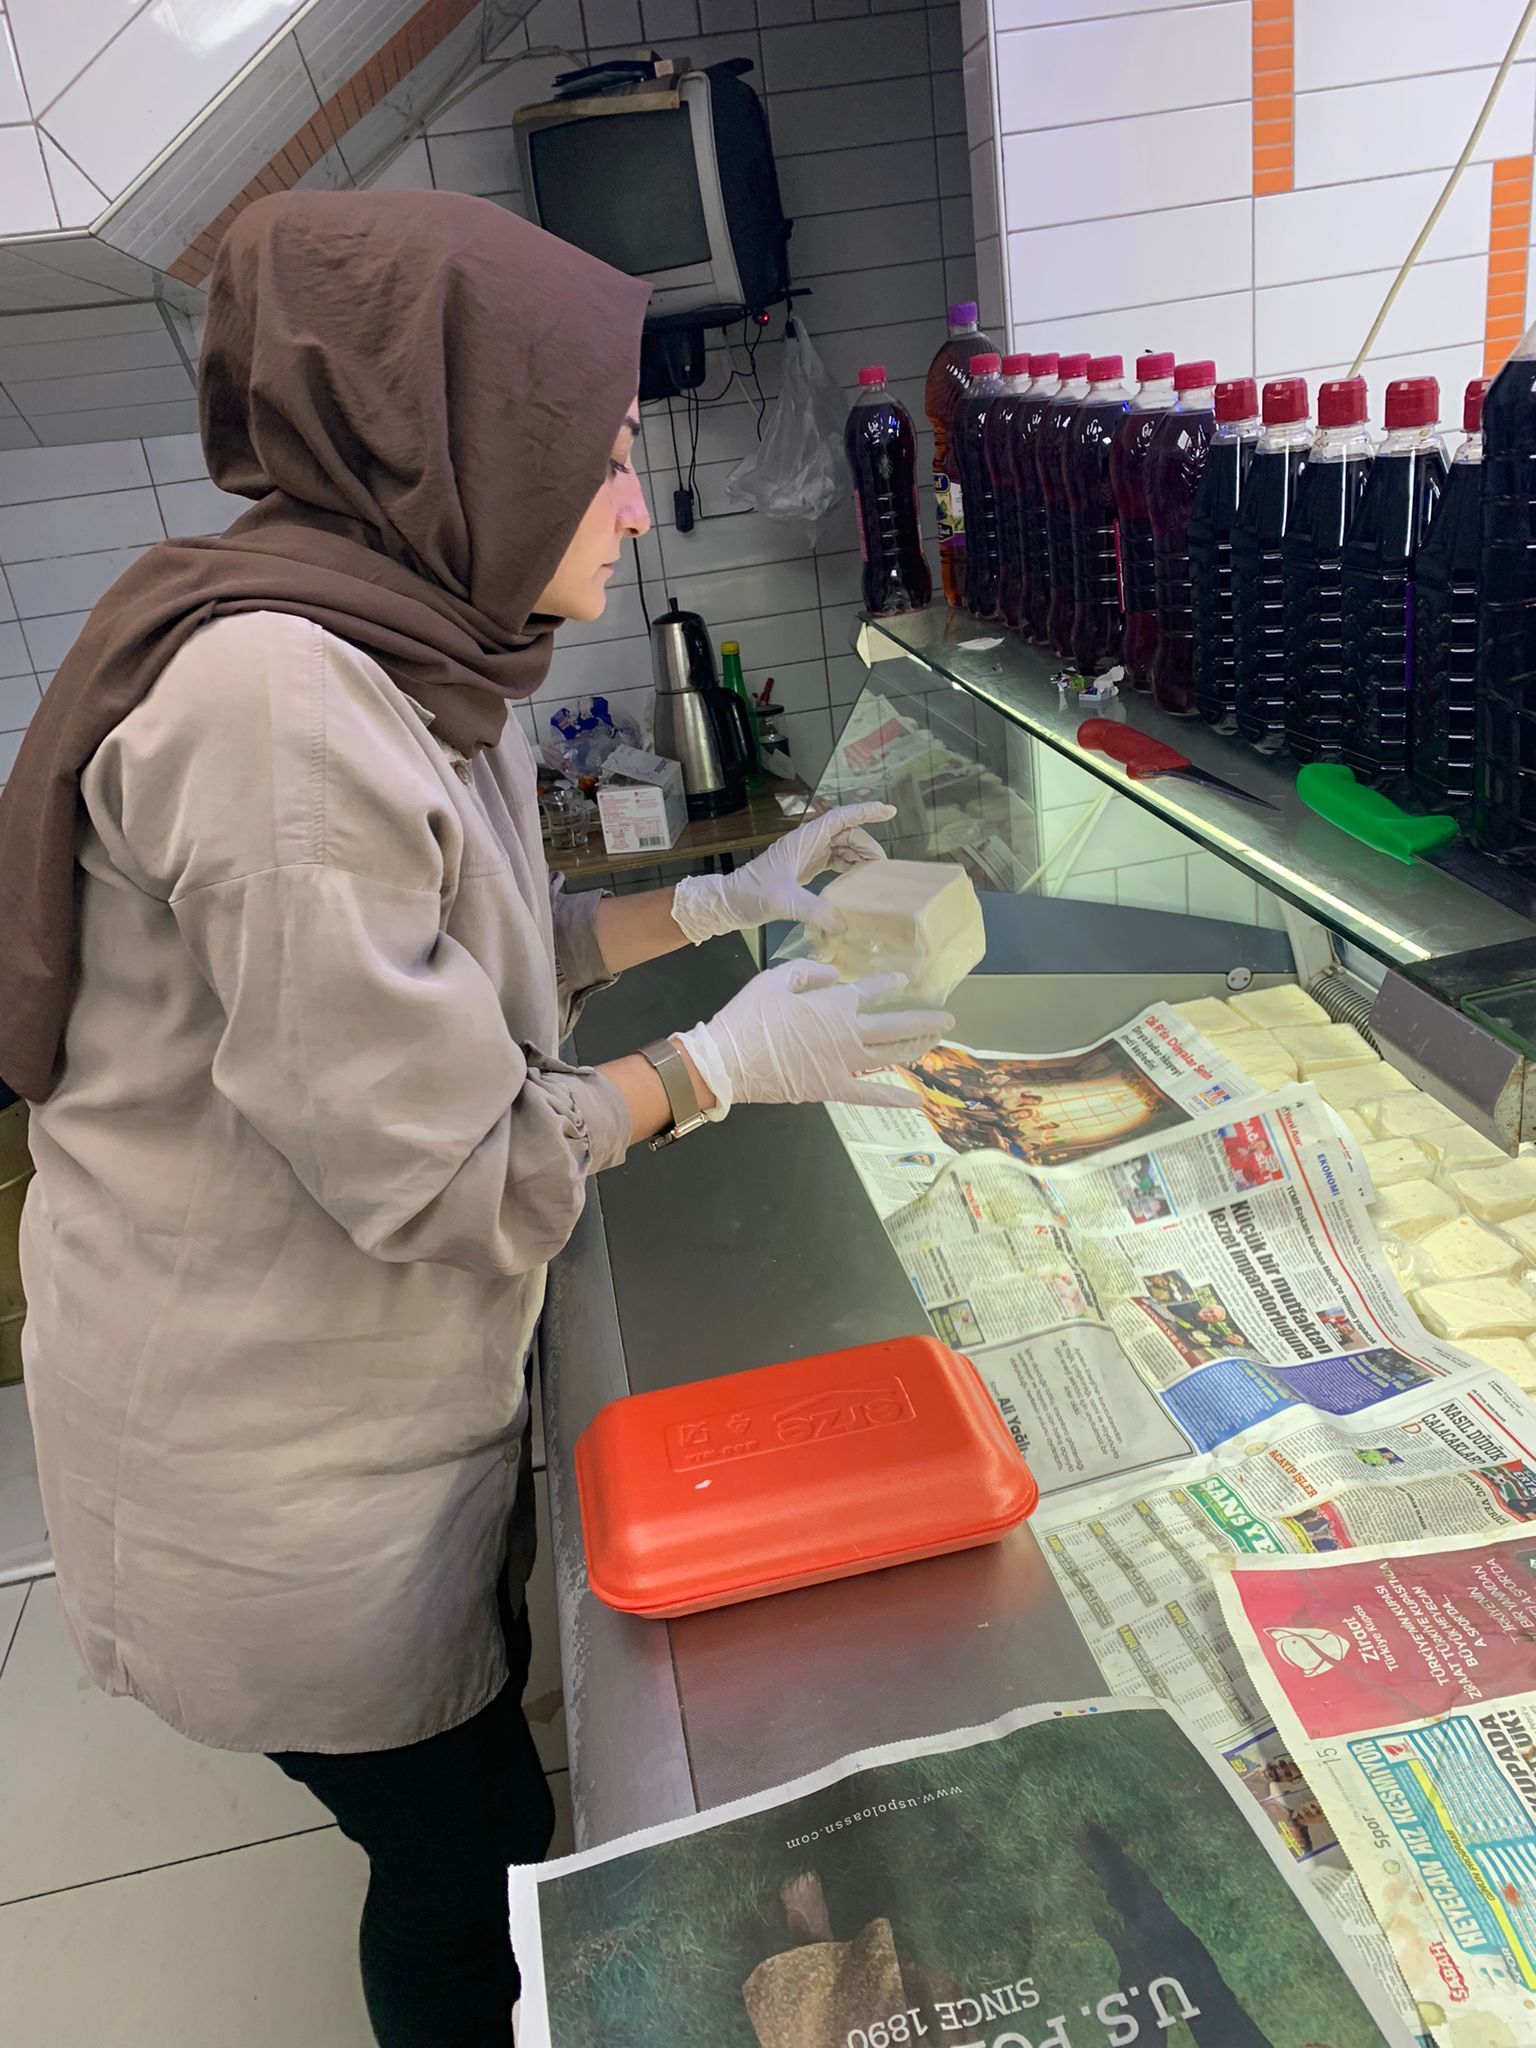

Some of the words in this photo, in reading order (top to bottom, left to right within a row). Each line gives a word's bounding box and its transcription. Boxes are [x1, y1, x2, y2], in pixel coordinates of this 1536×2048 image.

[1208, 1207, 1242, 1252] lezzet
[1230, 1248, 1314, 1360] imparatorluğuna
[1229, 1200, 1267, 1253] Küçük
[1255, 1252, 1281, 1276] bir
[1271, 1277, 1333, 1354] mutfaktan
[997, 1395, 1015, 1416] Ali
[1009, 1414, 1031, 1453] Yağlı
[1418, 1413, 1487, 1465] ÇALACAKLAR?
[1440, 1403, 1475, 1435] NASIL
[1466, 1429, 1507, 1461] DÜDÜK
[1269, 1448, 1297, 1476] ACAYİP
[1290, 1472, 1318, 1499] İŞLER
[1352, 1603, 1377, 1633] Kupası
[1374, 1582, 1405, 1618] KUPASI
[1411, 1584, 1451, 1631] HEYECAN
[1343, 1617, 1380, 1665] Ziraat
[1371, 1630, 1399, 1672] Türkiye
[1416, 1615, 1455, 1662] TÜRKİYE
[1445, 1627, 1478, 1669] BÜYÜK
[1474, 1636, 1487, 1650] A
[1447, 1658, 1483, 1701] ZİRAAT
[1316, 1742, 1342, 1768] 15
[1351, 1738, 1418, 1829] KESMİYOR
[786, 1785, 963, 1850] www.uspoloassn.com
[1362, 1816, 1391, 1850] Spor
[1400, 1822, 1437, 1863] HIZ
[1418, 1853, 1486, 1947] HEYECAN
[1428, 1941, 1471, 2003] SABAH
[847, 2006, 929, 2048] 1890
[934, 1977, 1040, 2032] SINCE
[1081, 1976, 1201, 2047] U.S.
